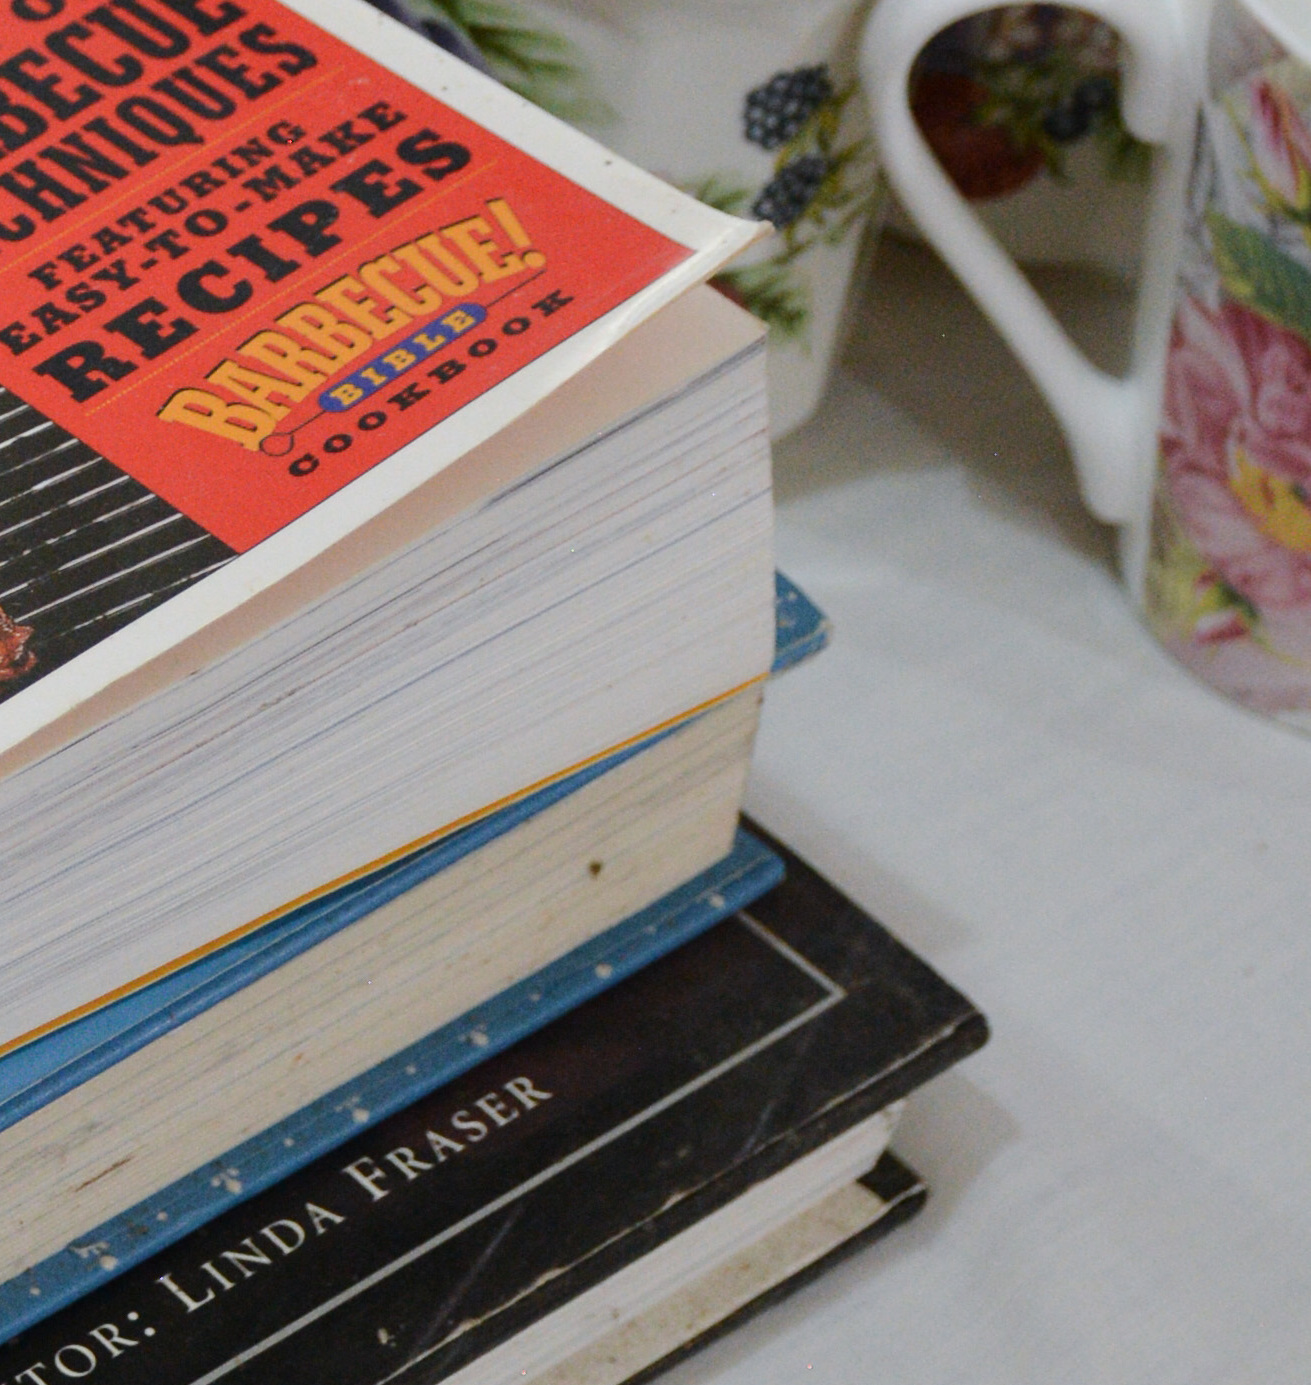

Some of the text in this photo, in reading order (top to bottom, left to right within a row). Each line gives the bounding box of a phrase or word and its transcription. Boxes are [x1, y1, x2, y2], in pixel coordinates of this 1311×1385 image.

[27, 119, 307, 291] FEATURING
[31, 127, 472, 404] RECIPES
[156, 196, 548, 453] BARBECUE!
[287, 288, 576, 478] COOKBOOK
[329, 308, 477, 408] BIBLE
[156, 1200, 346, 1313] LINDA
[342, 1074, 553, 1202] FRASER
